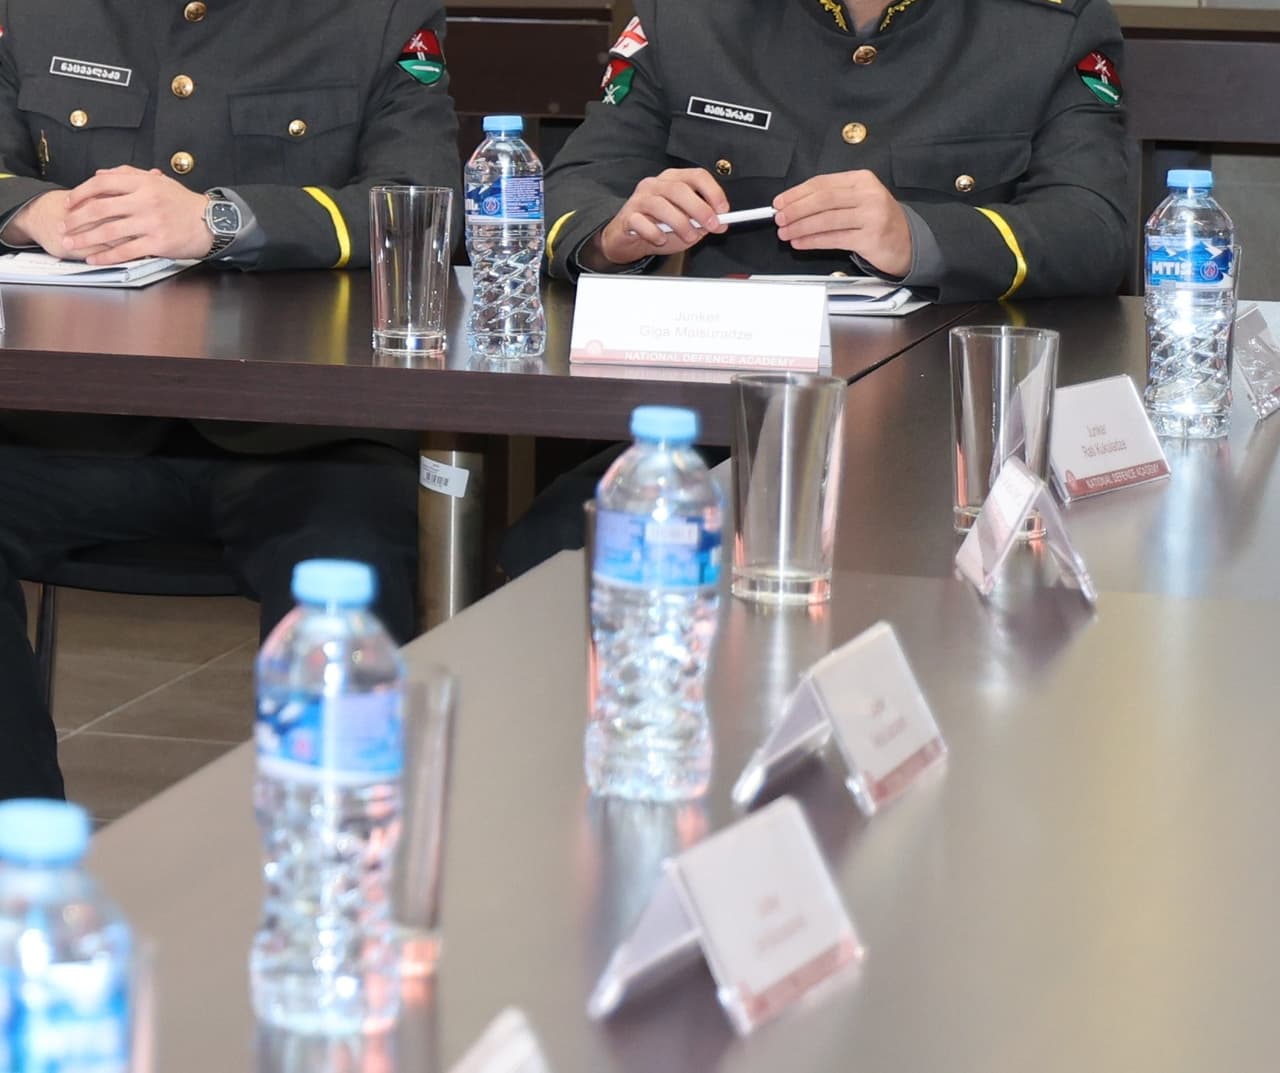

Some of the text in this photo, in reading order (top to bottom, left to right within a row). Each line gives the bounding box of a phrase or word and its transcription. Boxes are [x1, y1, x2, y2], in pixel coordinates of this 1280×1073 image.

[624, 351, 795, 367] NATIONAL DEFENCE ACADEMY
